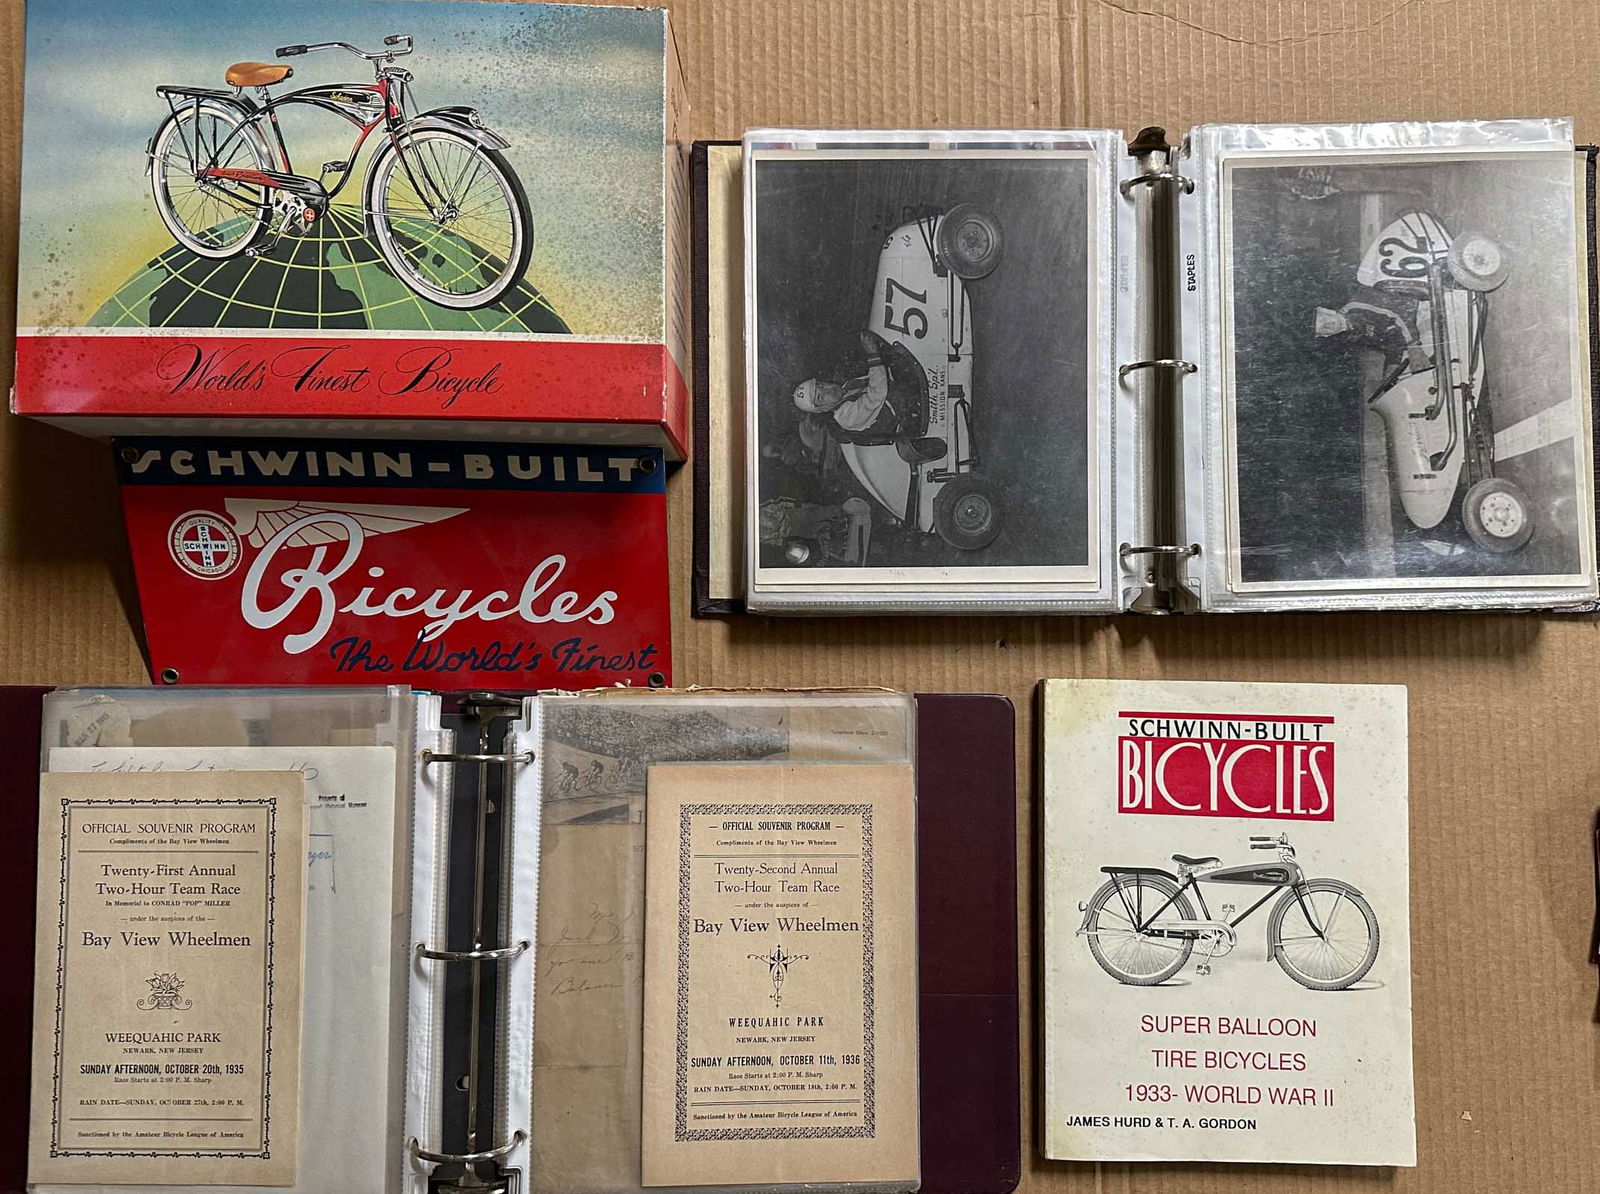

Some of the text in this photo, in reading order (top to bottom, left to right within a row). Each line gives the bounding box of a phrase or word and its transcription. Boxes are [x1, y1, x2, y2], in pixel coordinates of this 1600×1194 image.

[1378, 236, 1430, 278] 62
[1186, 254, 1196, 292] STAPLES
[884, 277, 928, 340] 57
[157, 343, 504, 409] World's Finest Bicycle
[929, 392, 938, 424] Smith
[241, 512, 619, 655] Bicycles
[329, 629, 658, 672] The World's Finest
[1129, 718, 1324, 742] SCHWINN-BUILT
[1122, 741, 1329, 816] BICYCLES
[82, 823, 256, 834] OFFICIAL SOUVENIR PROGRAM
[722, 822, 831, 831] OFFICIAL SOUVENIR PROGRAM
[101, 864, 236, 878] Twenty-First Annual
[714, 862, 838, 877] Twenty-Second Annual
[96, 882, 240, 895] Two-Hour Team Race
[714, 880, 840, 893] Two-Hour Team Race
[694, 918, 859, 936] Bay View Wheelmen
[82, 931, 251, 949] Bay View Wheelmen
[729, 1016, 824, 1029] WEEQUAHIC PARK
[1141, 1014, 1317, 1037] SUPER BALLOON
[106, 1032, 221, 1044] WEEQUAHIC PARK
[736, 1036, 769, 1044] NEWARK,
[691, 1055, 860, 1067] SUNDAY AFTERNOON, OCTOBER 11th, 1936
[1152, 1050, 1306, 1071] TIRE BICYCLES
[80, 1064, 244, 1076] SUNDAY AFTERNOON, OCTOBER 20th, 1935
[1125, 1085, 1334, 1106] 1933- WORLD WAR II
[1067, 1117, 1257, 1130] JAMES HURD & T. A. GORDON
